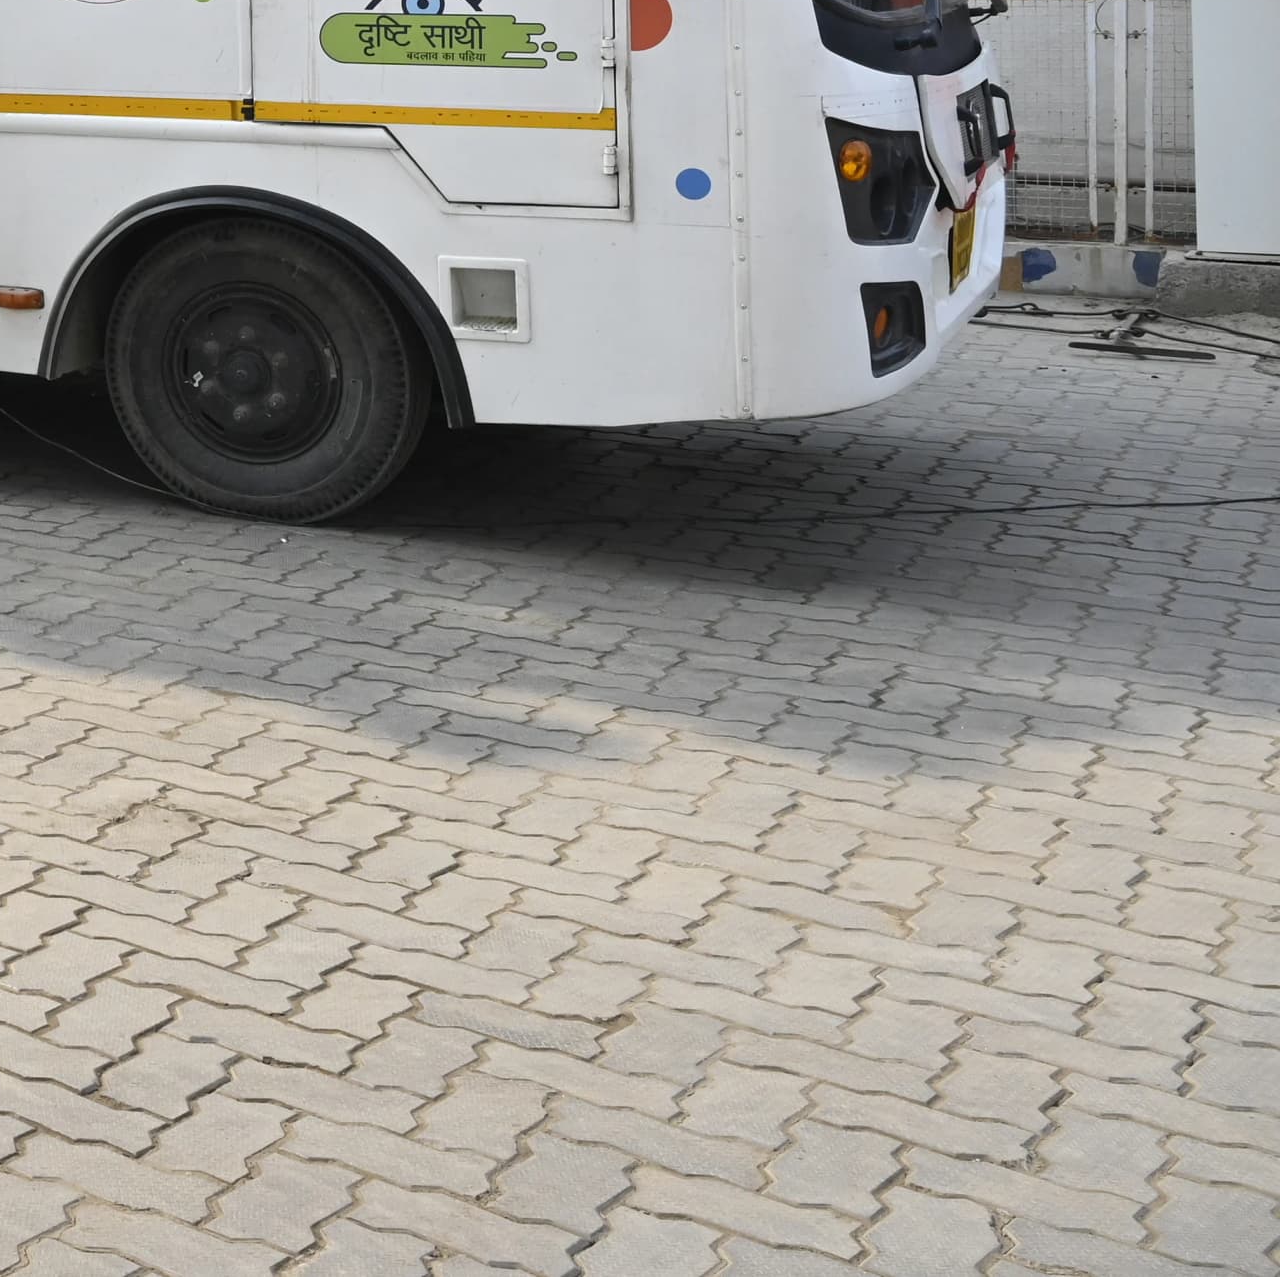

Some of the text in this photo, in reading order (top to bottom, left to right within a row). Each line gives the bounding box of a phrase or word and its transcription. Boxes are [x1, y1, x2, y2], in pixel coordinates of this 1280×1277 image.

[355, 15, 486, 56] दृष्टि साथी
[406, 50, 486, 62] बदलाव का पहिया
